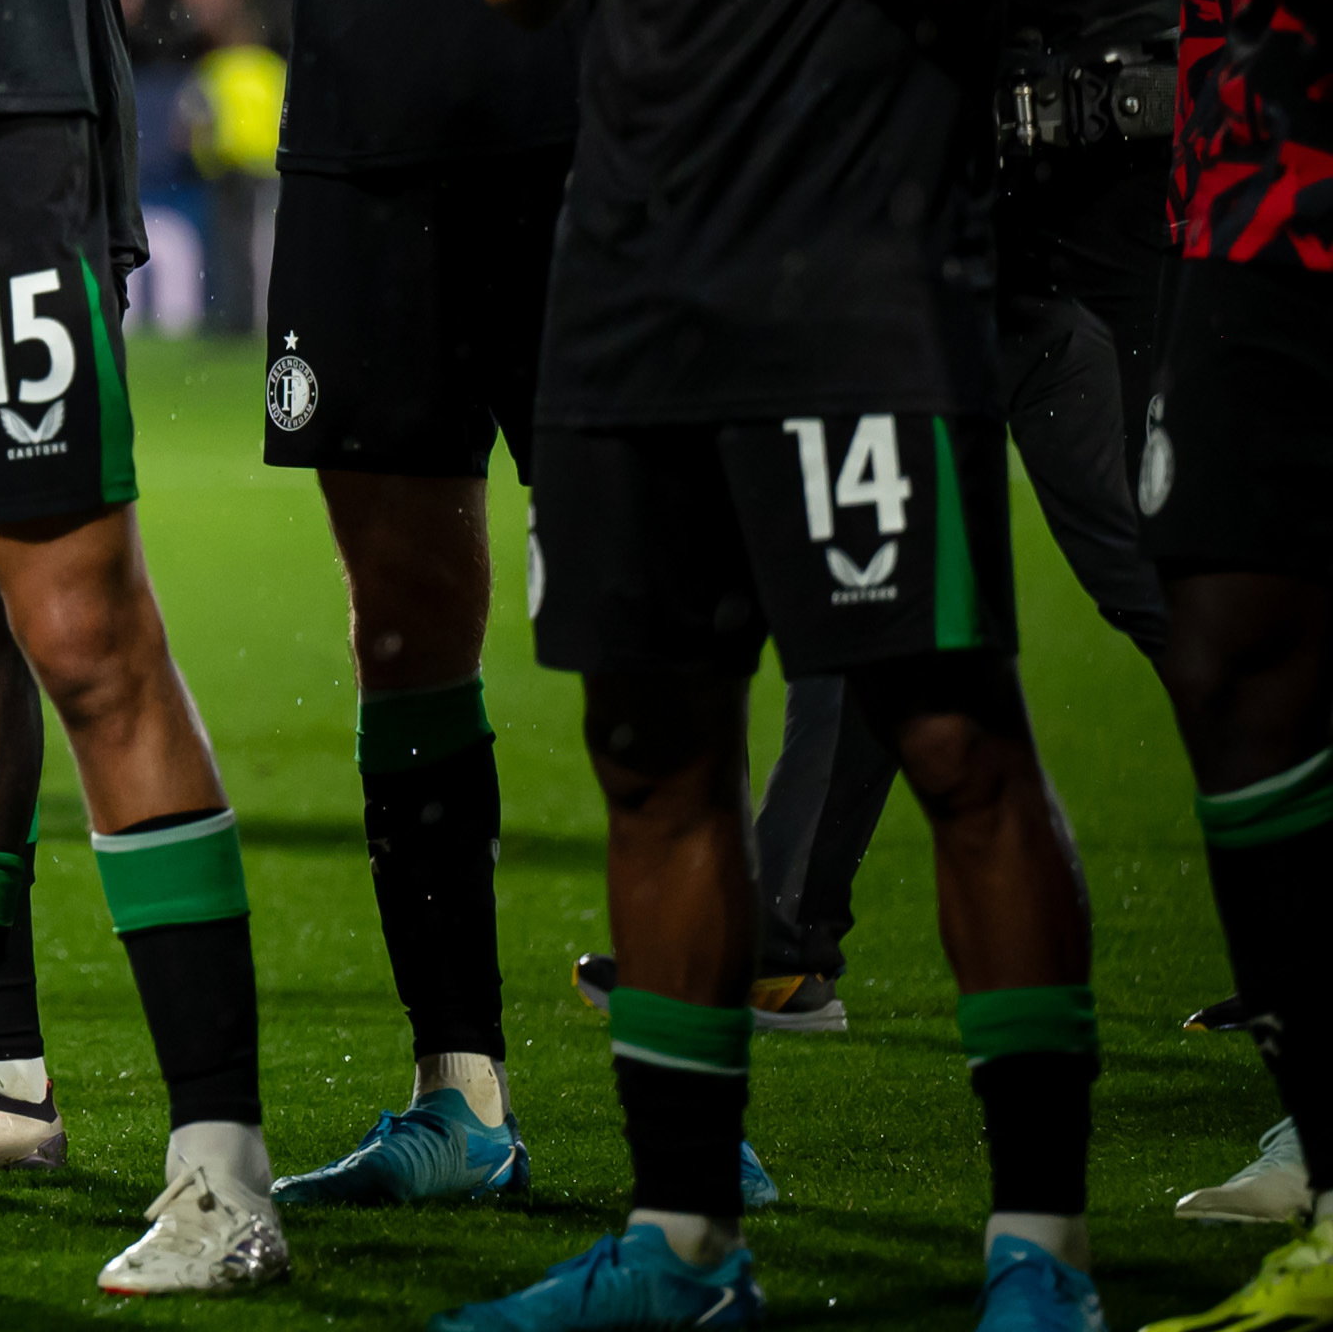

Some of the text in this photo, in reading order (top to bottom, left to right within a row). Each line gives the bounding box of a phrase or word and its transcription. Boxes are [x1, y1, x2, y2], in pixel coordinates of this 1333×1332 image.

[271, 359, 314, 384] FEYENOORD
[271, 403, 313, 428] ROTTERDAM
[783, 413, 913, 542] 14
